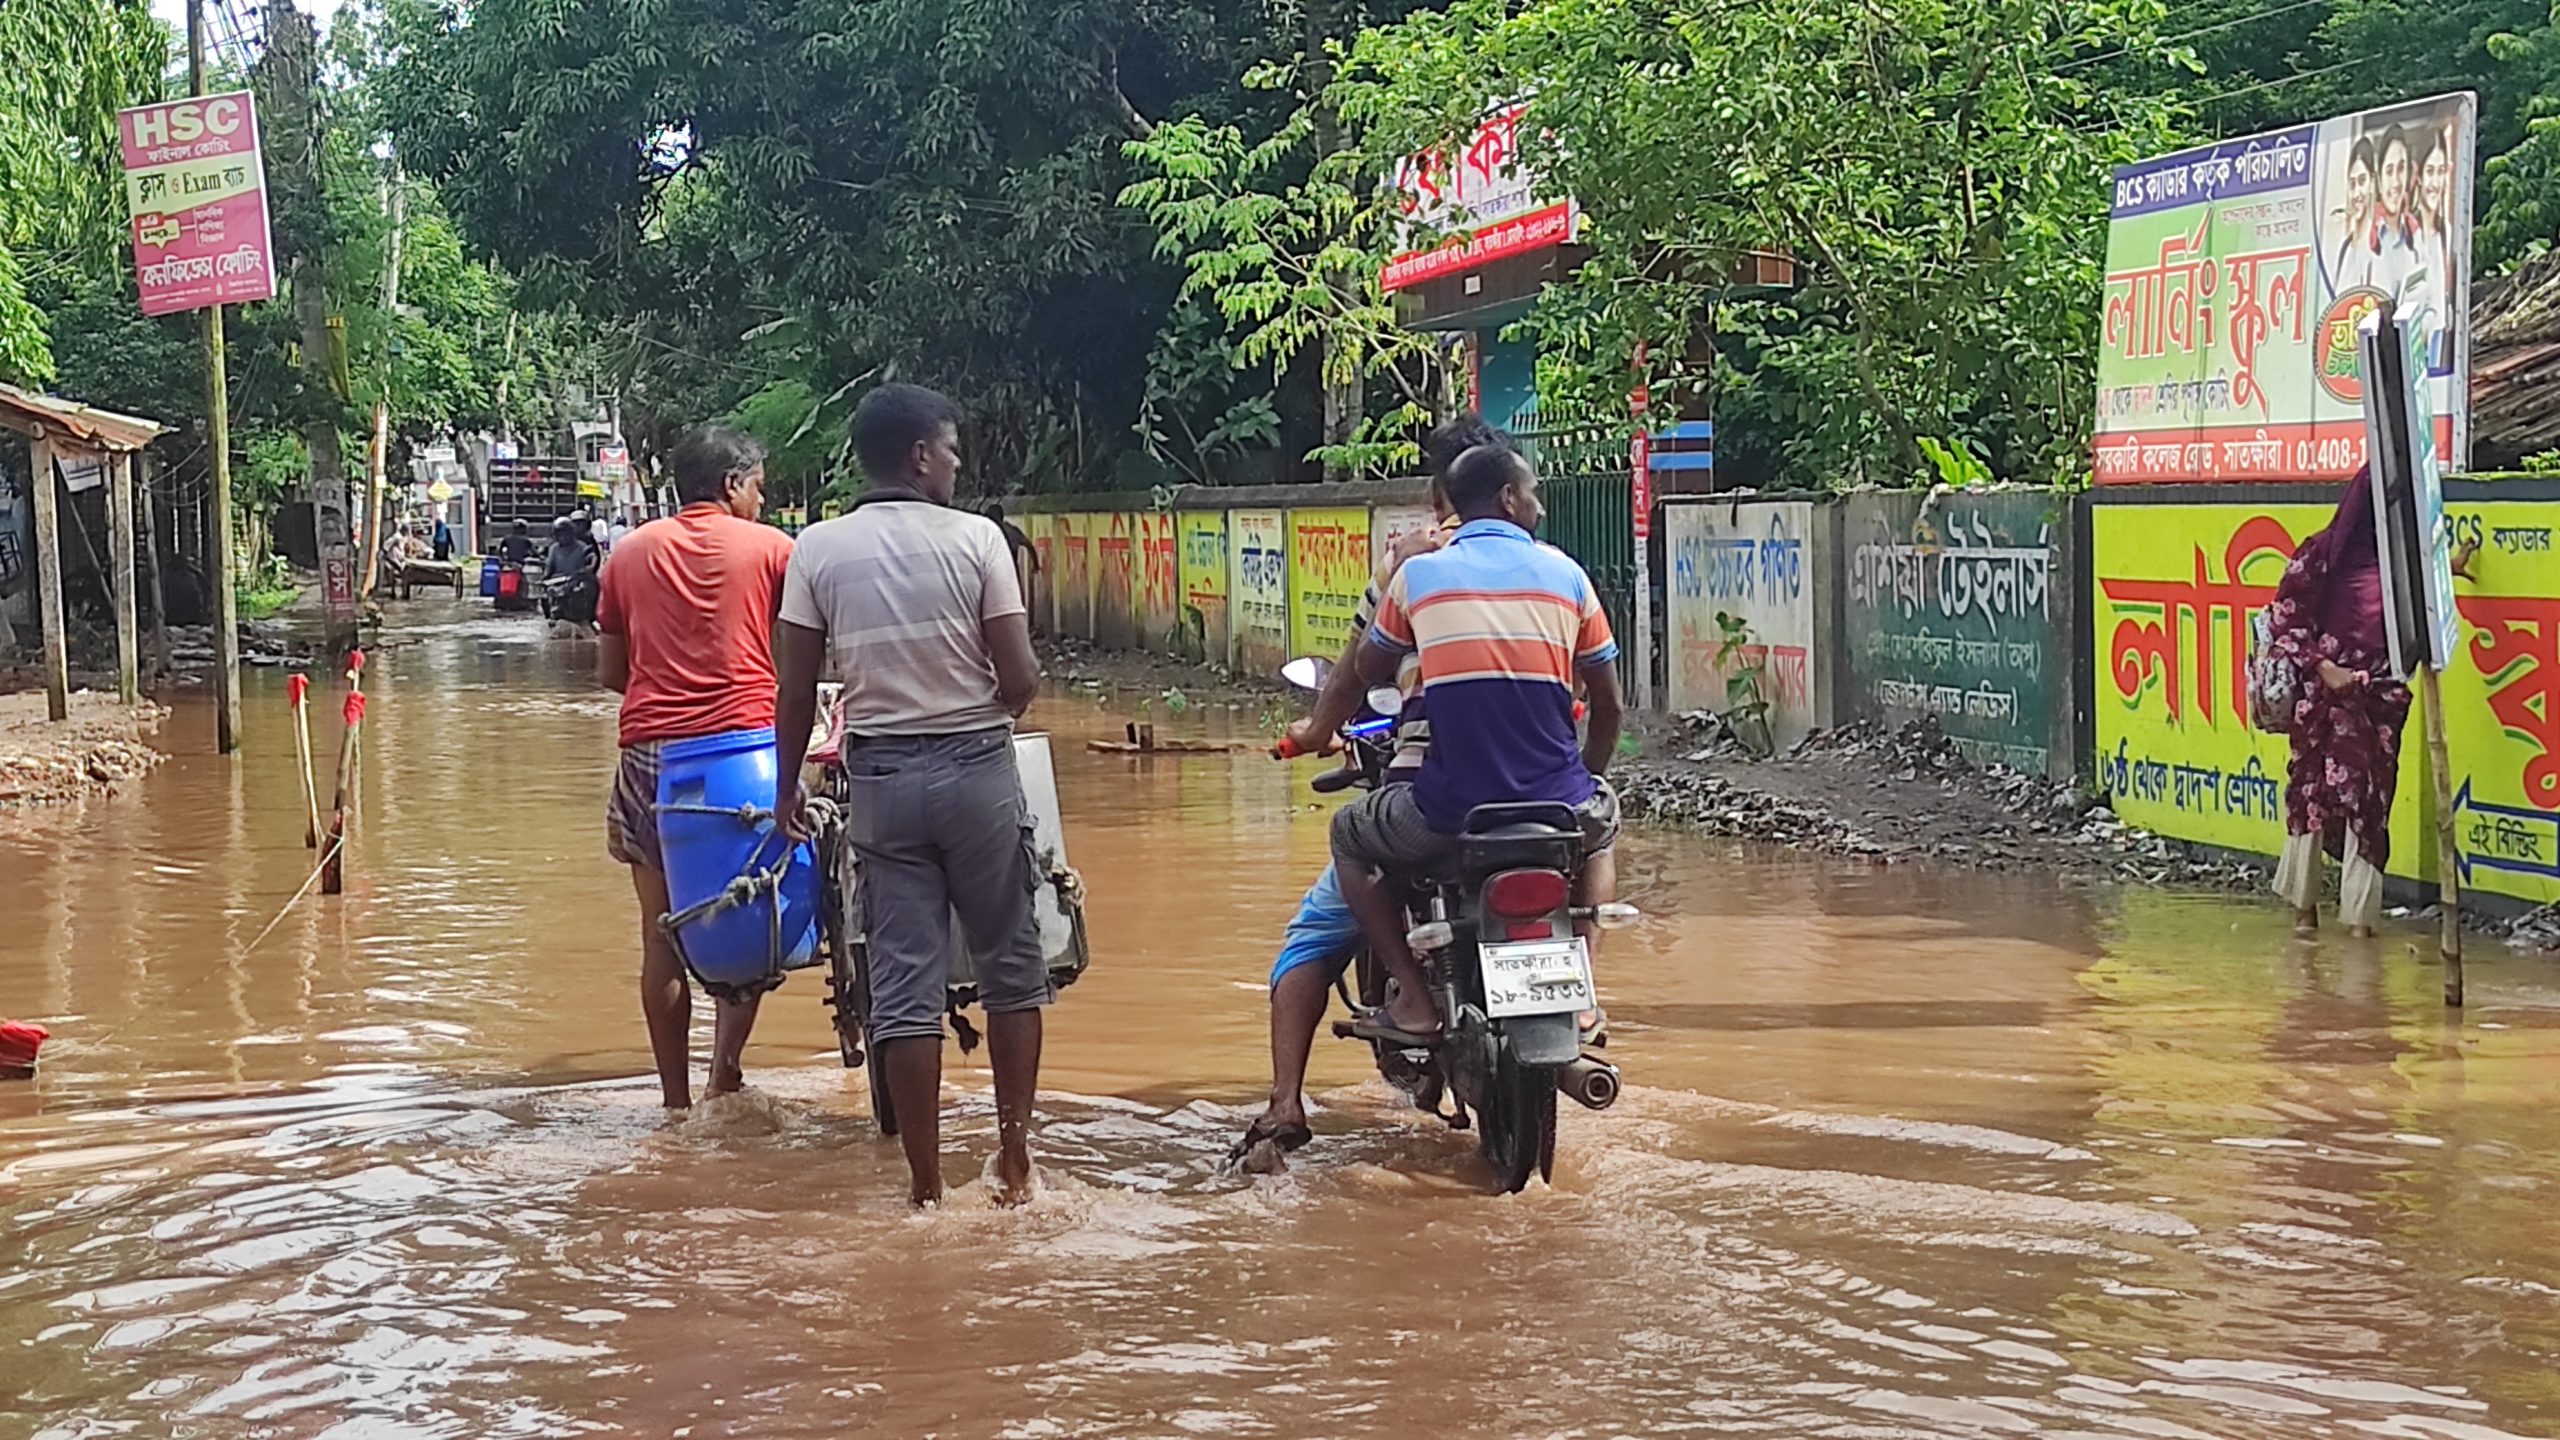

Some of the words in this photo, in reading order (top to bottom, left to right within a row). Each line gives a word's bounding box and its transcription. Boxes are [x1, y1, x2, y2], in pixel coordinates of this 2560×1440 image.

[133, 99, 240, 148] HSC
[137, 173, 167, 204] ক্লাস
[183, 171, 222, 194] Exam
[223, 167, 245, 188] ব্যাচ
[2115, 175, 2144, 208] BCS
[2146, 164, 2188, 201] ক্যাডার
[2191, 147, 2231, 201] কর্তৃক
[2235, 136, 2308, 183] পরিচালিত
[216, 244, 264, 277] কোচিং
[2105, 206, 2218, 359] লার্নিং
[2224, 246, 2311, 421] স্কুল
[2096, 435, 2139, 475] সরকারি
[2142, 443, 2182, 473] কলেজ
[2184, 443, 2220, 478] রোড,
[2223, 429, 2283, 474] সাতক্ষীরা
[1675, 536, 1701, 599] HSC
[1760, 511, 1801, 606] গণিত
[2443, 514, 2483, 549] BCS
[2492, 527, 2552, 554] ক্যাডার
[1937, 509, 2050, 636] টেইলার্স
[1956, 629, 2000, 668] ইসলাম
[2132, 756, 2168, 802] থেকে
[2173, 760, 2220, 813] দ্বাদশ
[2225, 754, 2279, 822] শ্রেণির
[2468, 813, 2492, 855] এই
[2495, 817, 2542, 860] বিল্ডিং
